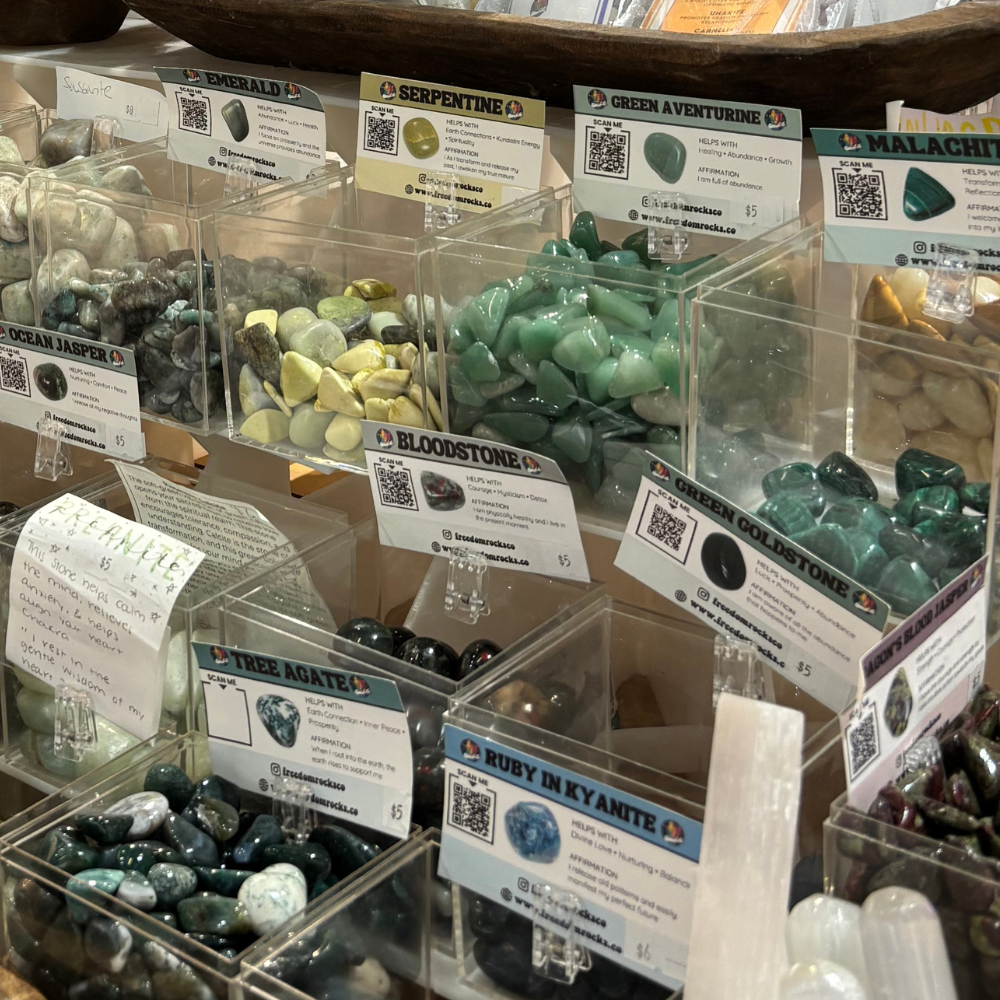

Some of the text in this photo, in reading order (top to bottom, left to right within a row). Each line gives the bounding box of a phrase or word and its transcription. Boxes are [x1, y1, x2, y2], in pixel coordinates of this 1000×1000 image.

[205, 72, 280, 97] EMERALD
[399, 84, 503, 115] SERPENTINE
[257, 104, 272, 113] HELPS
[371, 105, 385, 113] SCAN
[611, 95, 761, 125] GREEN AVENTURINE
[258, 125, 289, 136] AFFIRMATION
[446, 119, 479, 129] HELPS WITH
[593, 119, 611, 127] SCAN
[445, 127, 459, 136] Earth
[460, 130, 492, 141] Connections
[521, 139, 540, 150] Energy
[449, 136, 475, 147] Spirituality
[699, 137, 738, 149] HELPS WITH
[444, 147, 479, 158] AFFIRMATION
[699, 147, 793, 166] Healing Abundance Growth
[698, 166, 740, 178] AFFIRMATION
[839, 160, 860, 168] SCAN
[962, 168, 987, 176] HELPS
[745, 204, 757, 218] $5
[8, 327, 109, 364] OCEAN JASPER
[115, 435, 125, 447] $5
[396, 430, 521, 470] BLOODSTONE
[379, 456, 394, 464] SCAN
[466, 475, 502, 486] HELPS WITH
[471, 498, 509, 511] AFFIRMATION
[657, 488, 691, 514] SCAN ME
[141, 502, 184, 520] encourages
[179, 505, 211, 520] spiritual
[206, 530, 231, 544] Calcite
[675, 477, 850, 599] GREEN GOLDSTONE
[100, 557, 112, 571] $5
[558, 554, 571, 567] $5
[757, 560, 799, 592] HELPS WITH
[751, 582, 796, 616] AFFIRMATION
[755, 568, 771, 581] Luck
[776, 581, 810, 610] Prosperity
[816, 608, 856, 639] Abundance
[903, 579, 969, 646] BLOOD JASPER
[712, 597, 783, 650] freedomrocksco
[230, 650, 349, 693] TREE AGATE
[797, 661, 812, 678] $5
[207, 673, 237, 686] SCAN ME
[305, 697, 344, 711] HELPS WITH
[306, 707, 401, 735] Earth Connection Inner Peace
[308, 718, 340, 733] Prosperity
[310, 735, 351, 751] AFFIRMATION
[282, 766, 346, 792] freedomrocksco
[457, 768, 489, 787] SCAN ME
[485, 748, 657, 834] RUBY IN KYANITE
[391, 803, 403, 821] $5
[572, 818, 618, 845] HELPS WITH
[571, 830, 653, 875] Divine Love Nurturing
[569, 852, 618, 880] AFFIRMATION
[637, 942, 651, 961] $6
